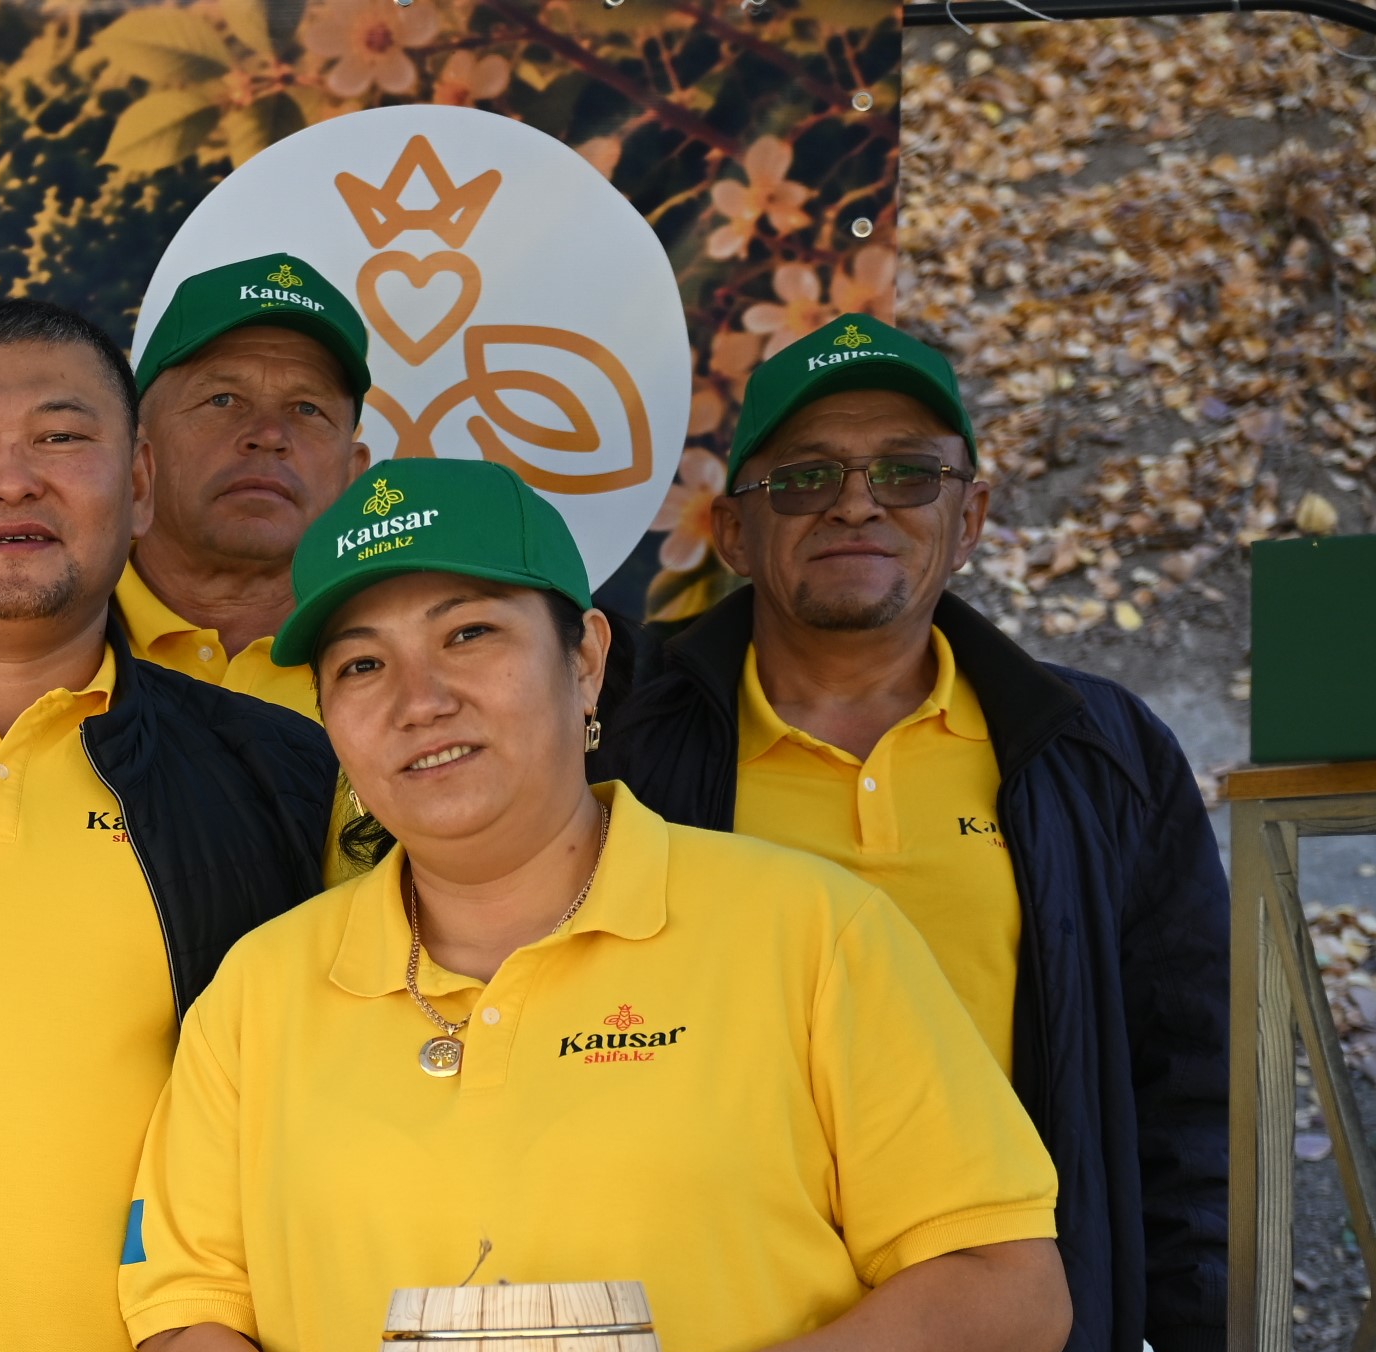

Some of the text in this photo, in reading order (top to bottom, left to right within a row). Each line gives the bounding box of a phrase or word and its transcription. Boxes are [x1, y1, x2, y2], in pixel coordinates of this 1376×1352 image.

[240, 285, 324, 311] Kausar
[337, 509, 439, 558] Kausar
[357, 536, 414, 561] shifa.kz
[559, 1026, 686, 1058] Kausar
[584, 1050, 655, 1064] shifa.kz
